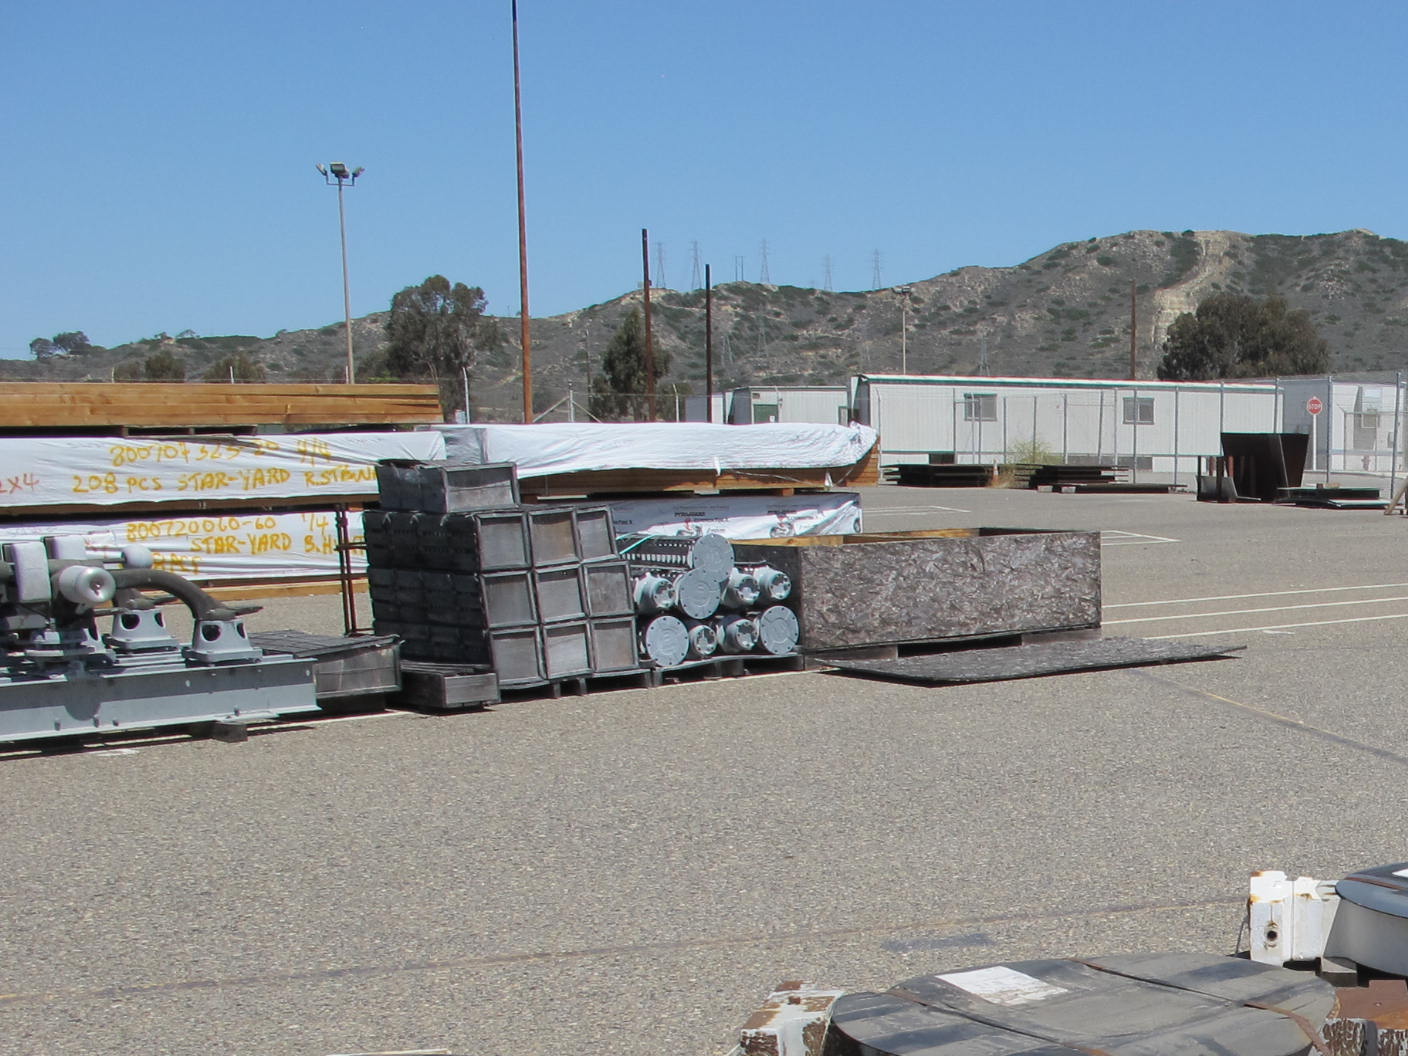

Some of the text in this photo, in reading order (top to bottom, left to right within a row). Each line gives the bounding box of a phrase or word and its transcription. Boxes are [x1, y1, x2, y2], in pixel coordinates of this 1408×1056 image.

[72, 472, 119, 494] 208
[178, 466, 291, 492] STAR-YARD
[191, 533, 293, 555] STAR-YARD
